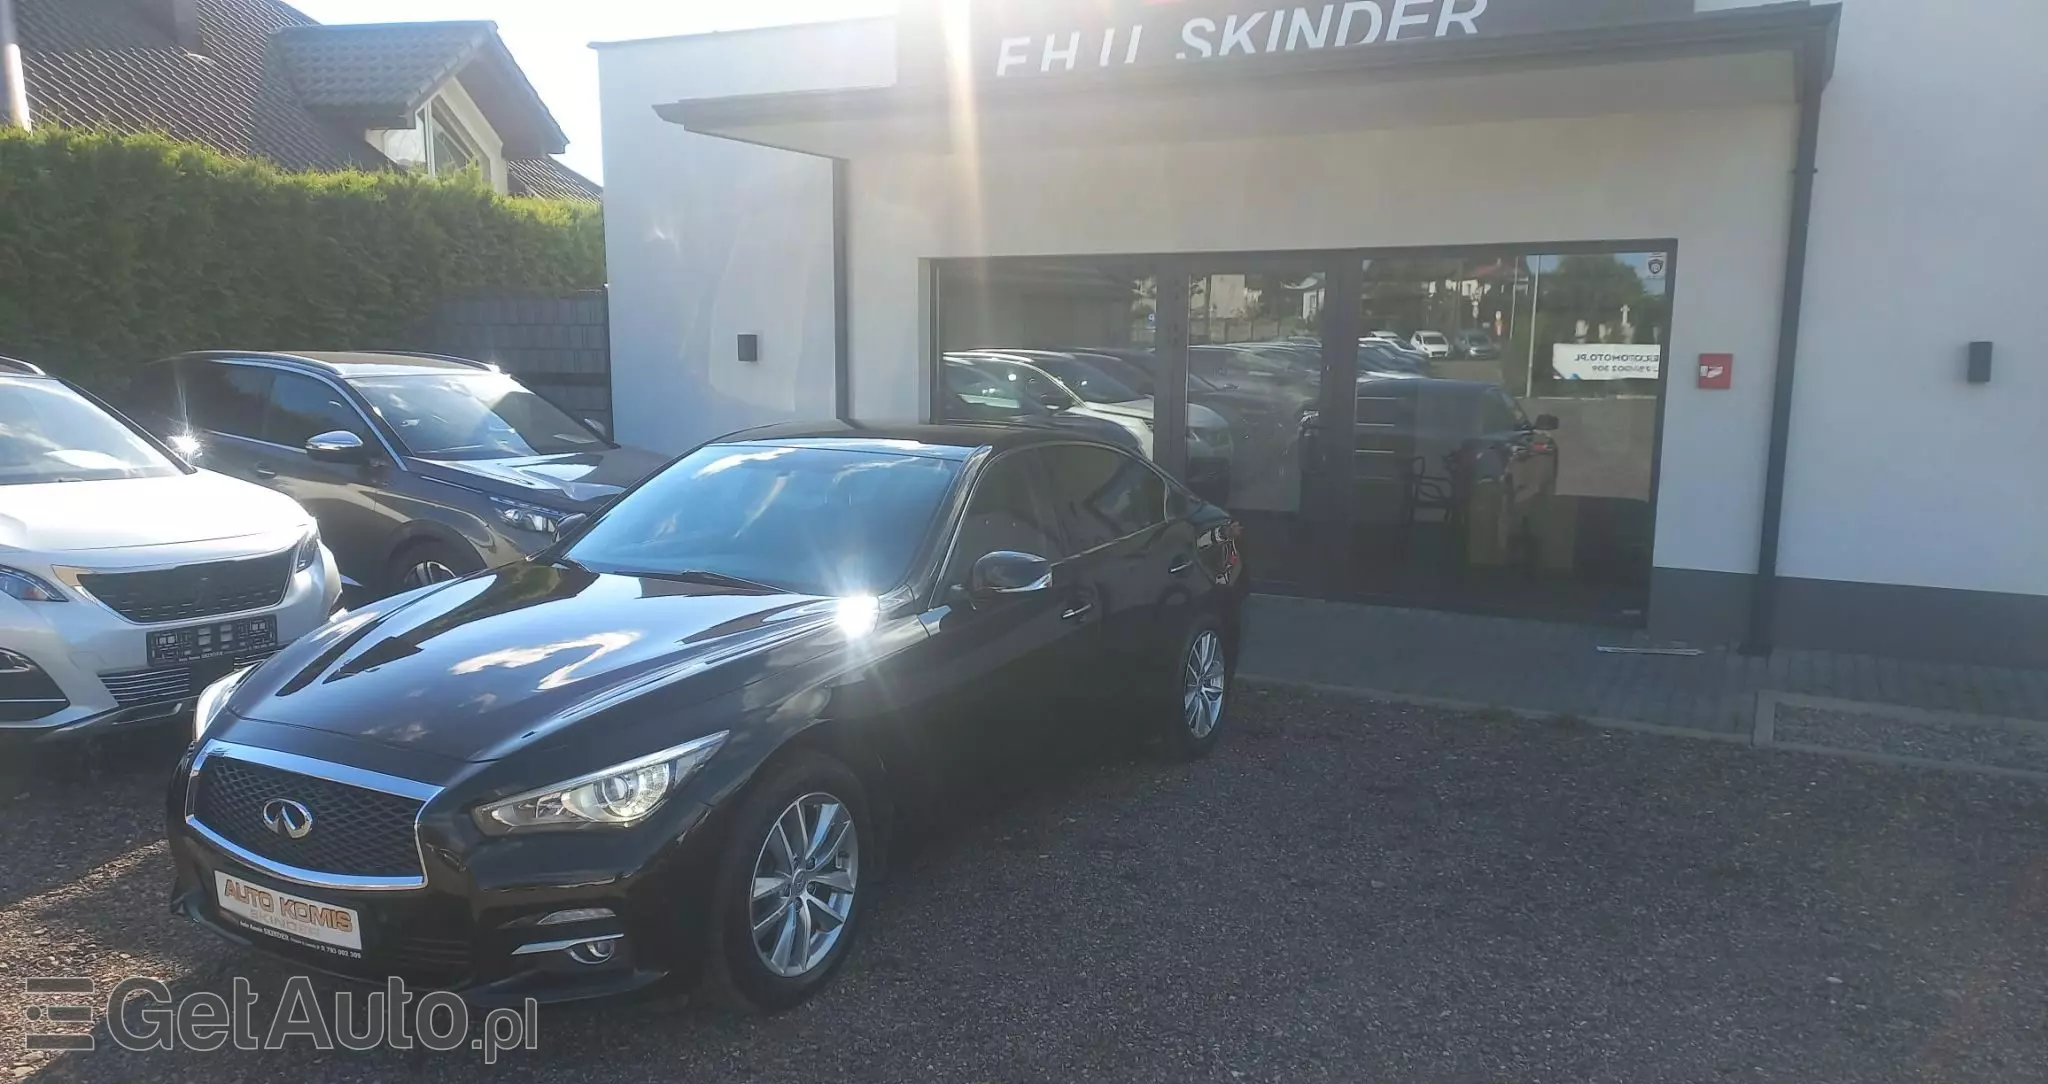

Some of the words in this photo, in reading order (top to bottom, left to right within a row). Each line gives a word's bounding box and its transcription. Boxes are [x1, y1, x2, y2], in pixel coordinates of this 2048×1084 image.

[1175, 0, 1488, 60] SKINDER
[225, 879, 274, 912] AUTO
[279, 897, 353, 932] KOMIS
